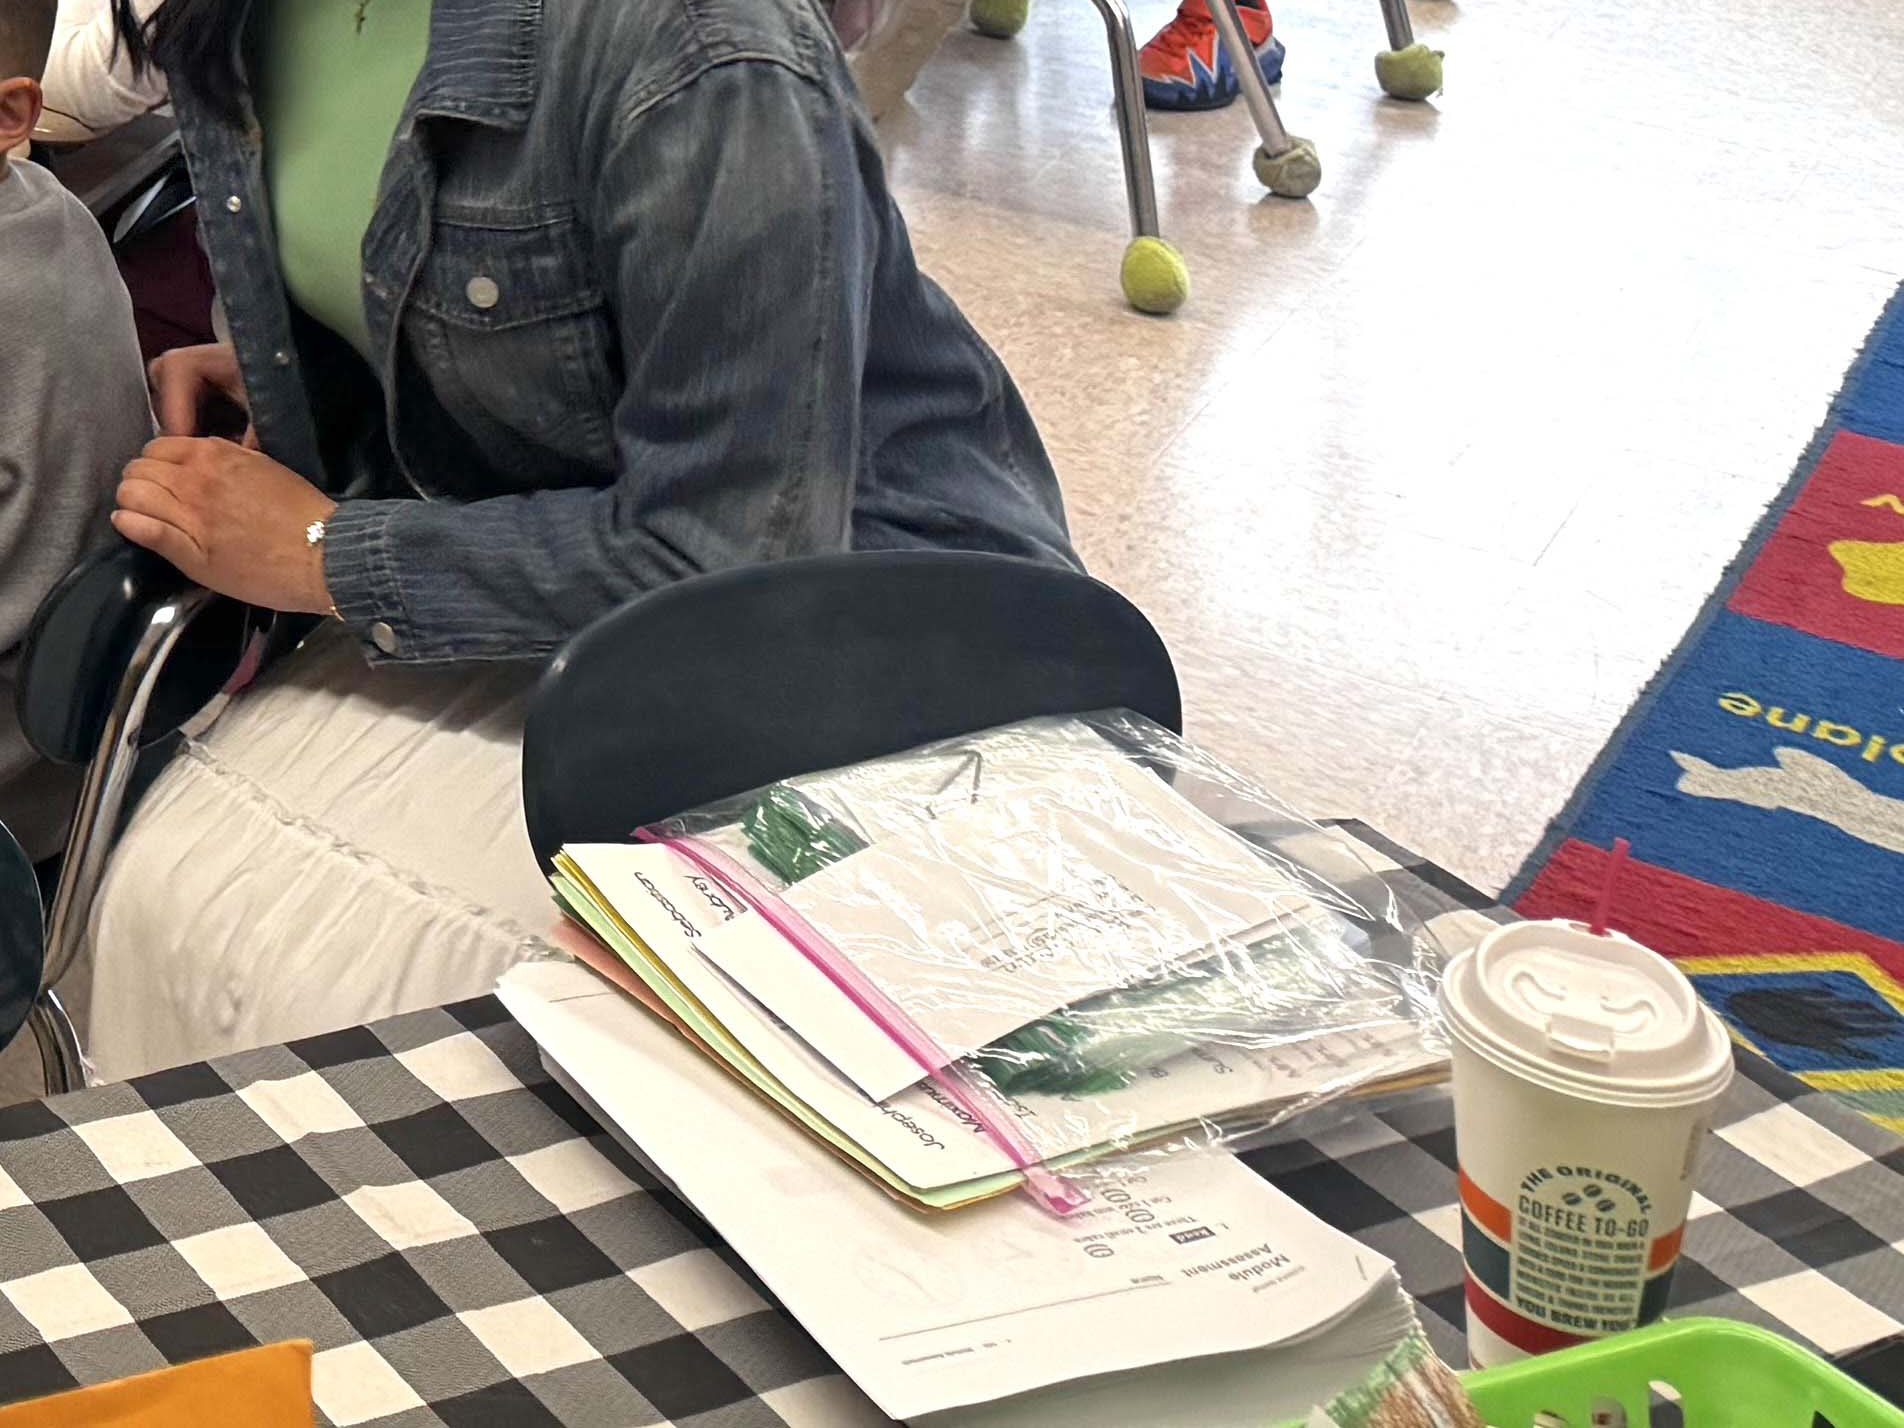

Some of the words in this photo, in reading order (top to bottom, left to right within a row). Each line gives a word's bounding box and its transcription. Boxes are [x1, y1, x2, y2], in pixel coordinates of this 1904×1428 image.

[1521, 1168, 1553, 1192] THE
[1557, 1166, 1652, 1214] ORIGINAL
[1519, 1195, 1585, 1232] COFFEE
[1595, 1217, 1648, 1237] TO-GO
[1181, 1243, 1272, 1278] Assessment
[1229, 1254, 1290, 1280] Module
[1551, 1310, 1596, 1329] BREW
